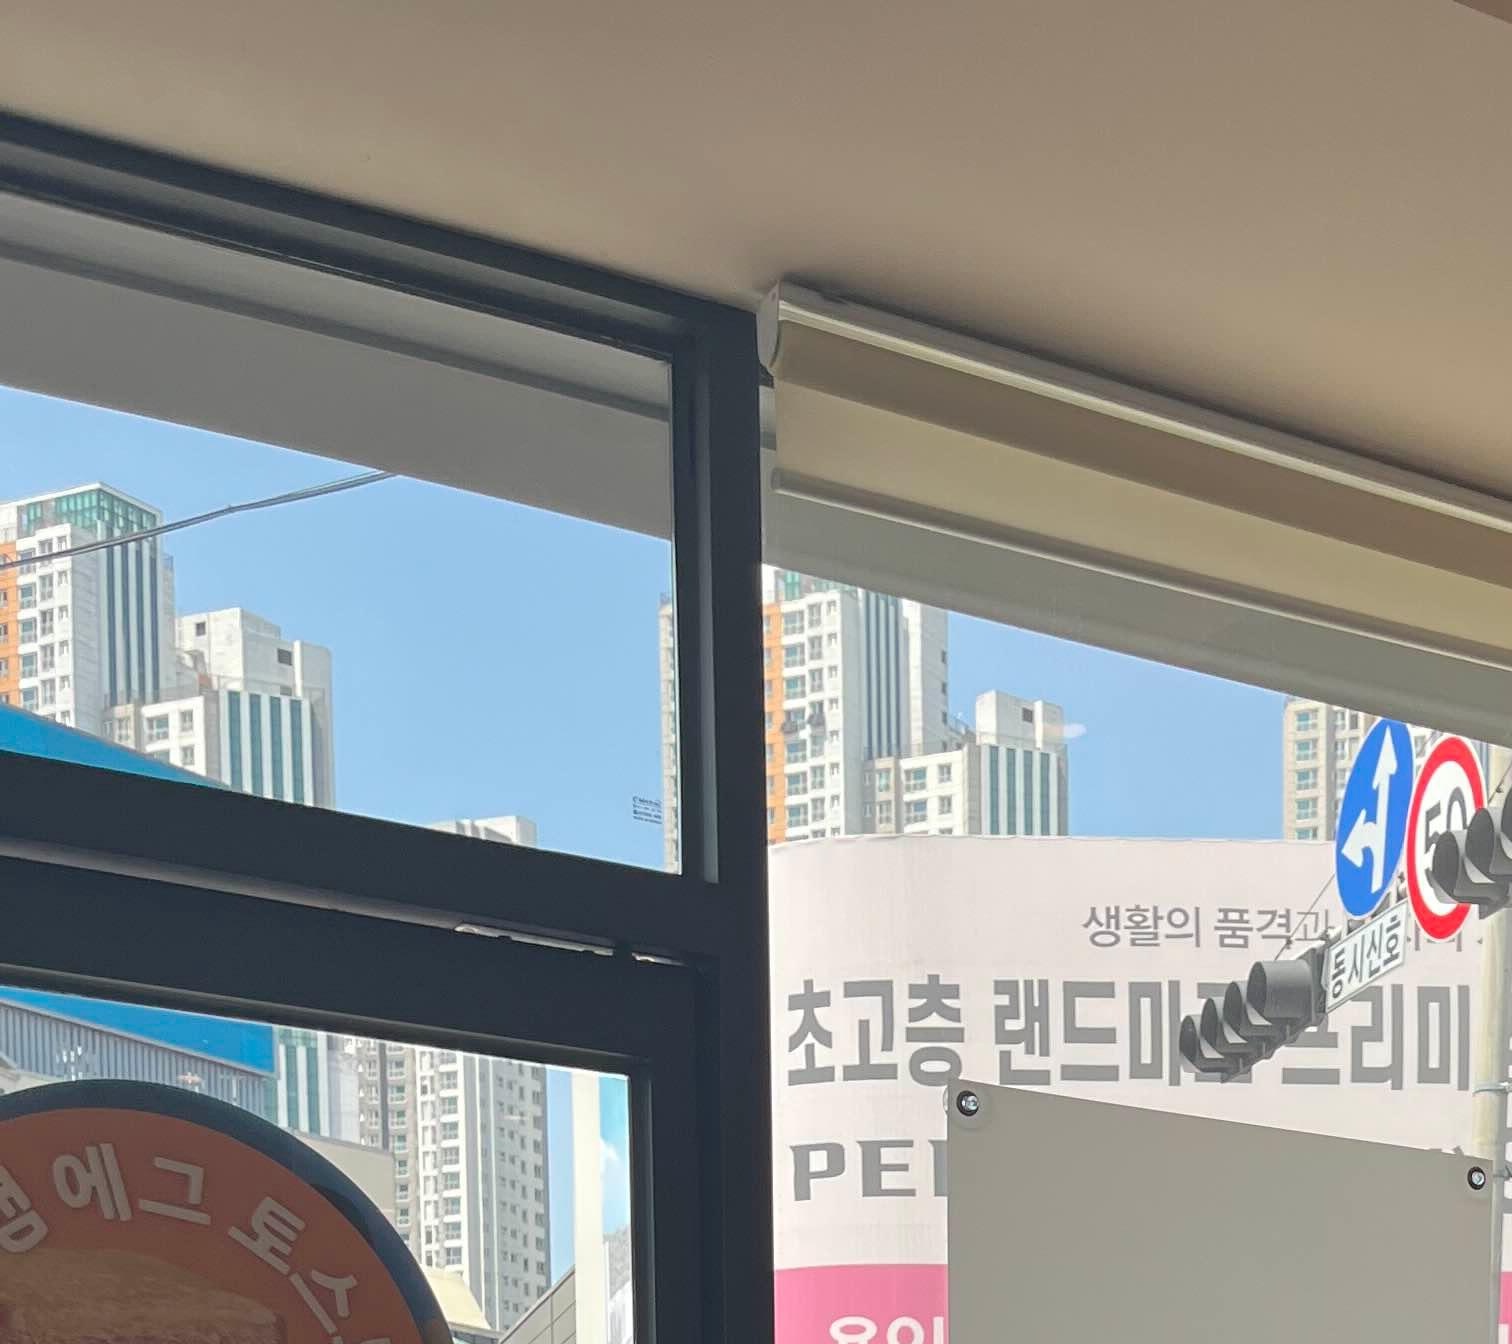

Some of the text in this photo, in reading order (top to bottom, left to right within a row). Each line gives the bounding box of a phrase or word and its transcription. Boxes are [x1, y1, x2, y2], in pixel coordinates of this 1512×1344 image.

[1082, 904, 1332, 950] 생활의 품격과
[1332, 914, 1400, 999] 동시신호
[787, 974, 965, 1087] 초고층
[993, 978, 1253, 1087] 랜드마
[788, 1139, 948, 1202] PE
